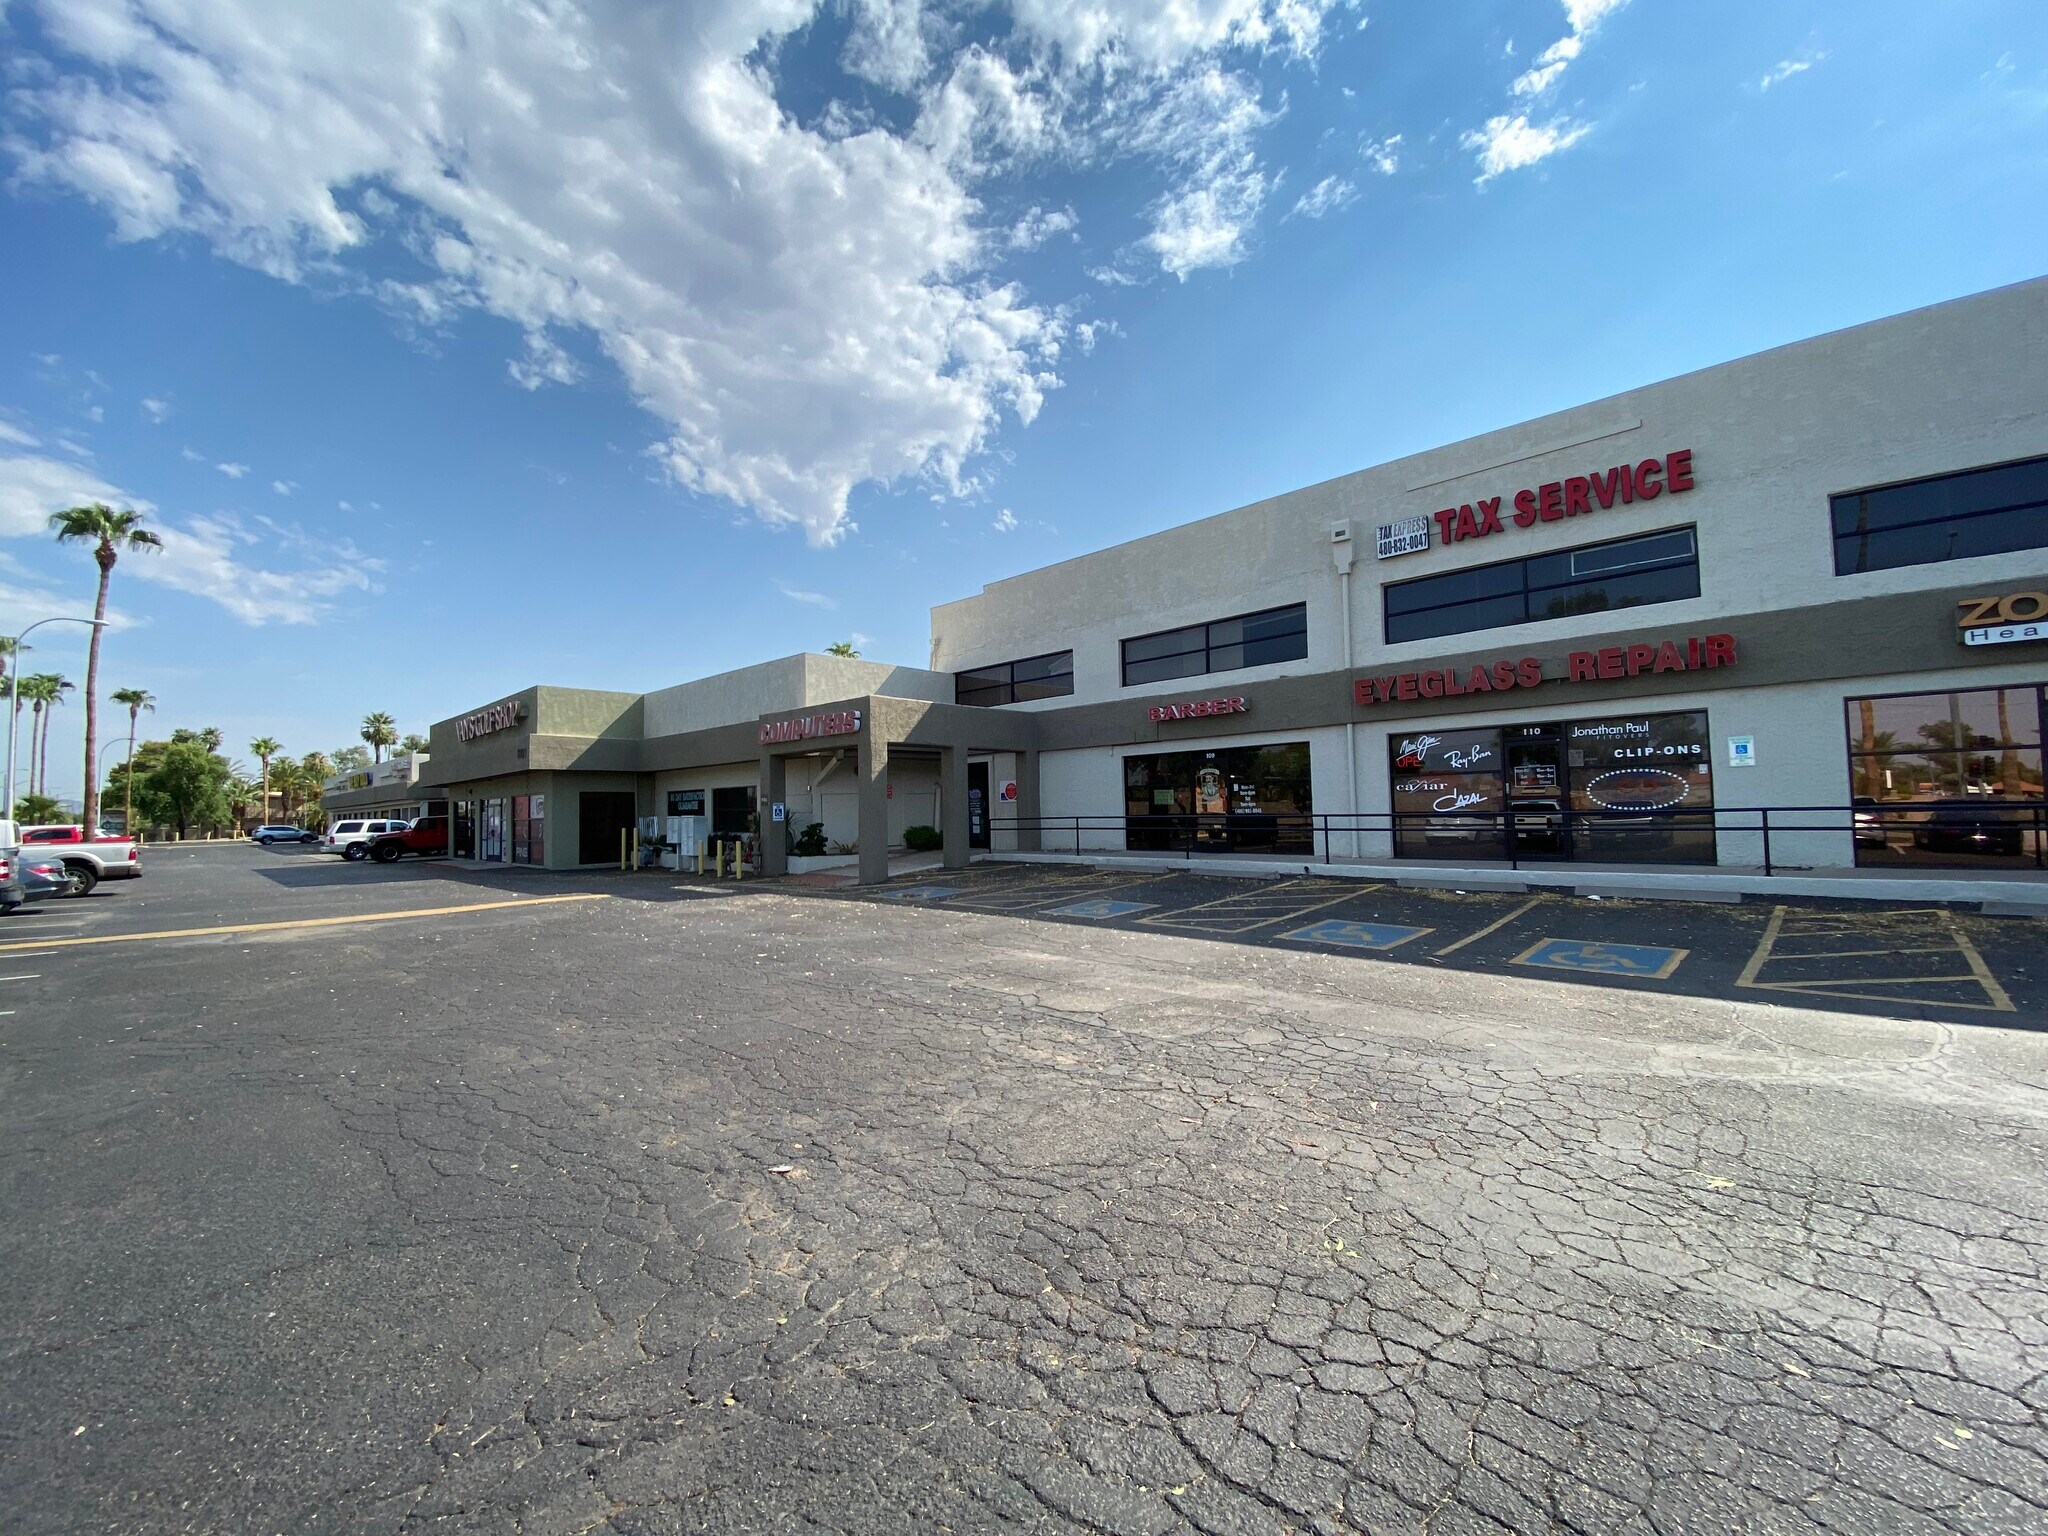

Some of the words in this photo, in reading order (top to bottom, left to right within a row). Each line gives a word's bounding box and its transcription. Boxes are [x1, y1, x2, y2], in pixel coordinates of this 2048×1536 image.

[1434, 497, 1505, 544] TAX
[1513, 449, 1694, 527] SERVICE
[1379, 525, 1392, 541] TAX
[1393, 517, 1426, 537] EXPRESS
[1379, 533, 1427, 555] 480-832-0047
[1958, 592, 2048, 627] ZO
[1970, 627, 2039, 641] Hea
[1354, 657, 1542, 704] EYEGLASS
[1569, 633, 1738, 682] REPAIR
[1148, 697, 1246, 722] BARBER
[758, 709, 861, 745] COMPUTERS
[1572, 724, 1623, 738] Jonathan
[1626, 721, 1649, 733] Paul
[1444, 745, 1491, 768] Ray-Ban
[1614, 744, 1701, 758] CLIP-ONS
[1433, 788, 1487, 811] CAZAL
